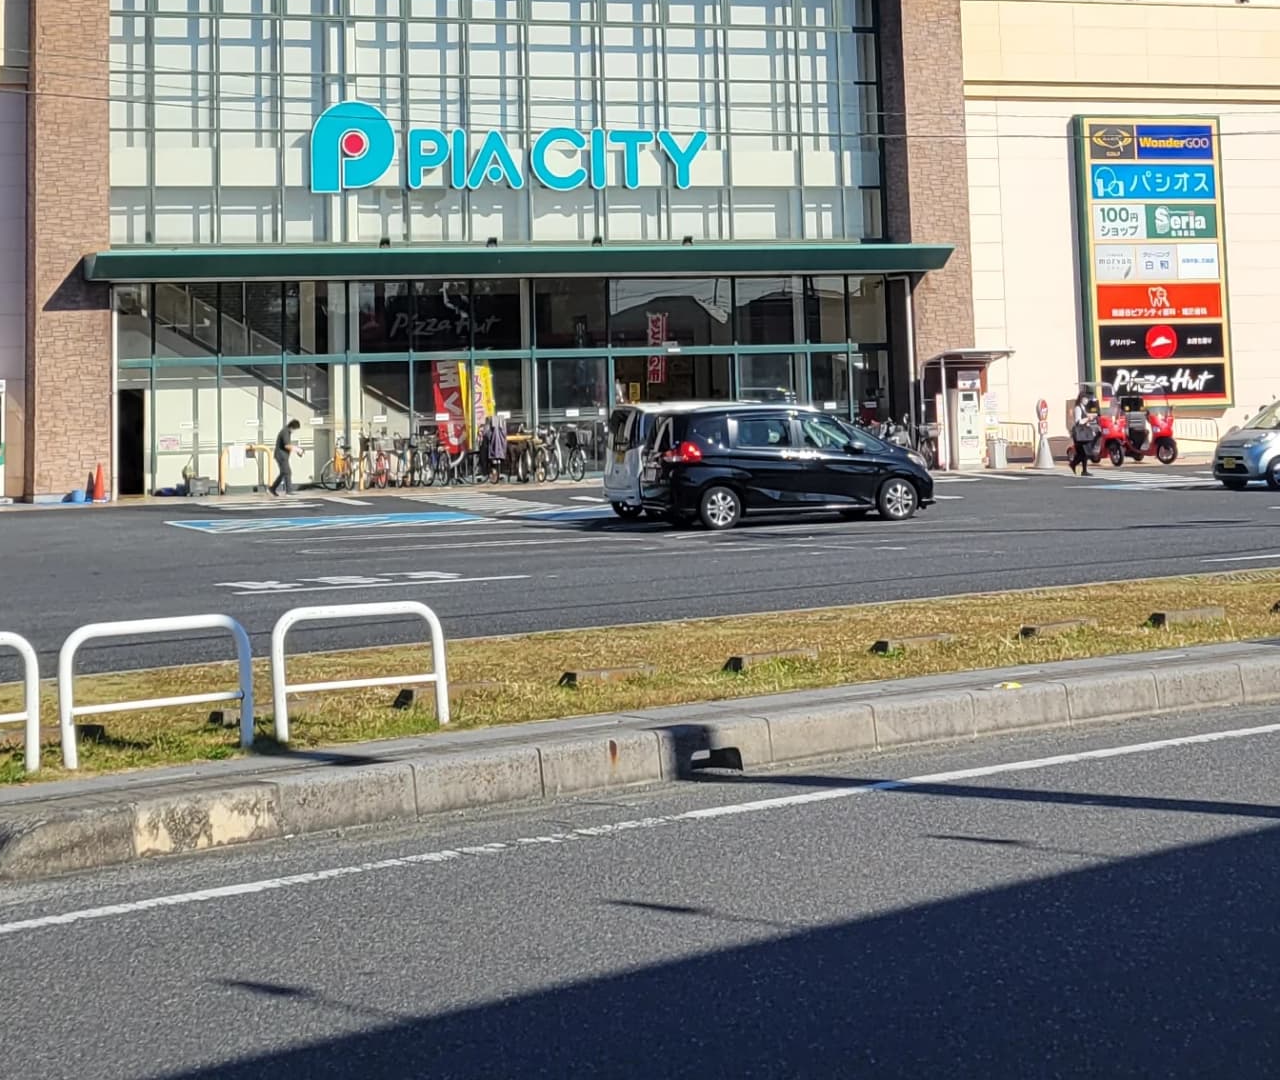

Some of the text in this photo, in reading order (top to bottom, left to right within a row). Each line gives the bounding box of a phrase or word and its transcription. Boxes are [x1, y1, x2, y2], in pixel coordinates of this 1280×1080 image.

[1139, 137, 1209, 148] WonderGOO
[1130, 171, 1209, 192] パシオス
[1100, 207, 1138, 223] 100円
[1155, 206, 1206, 234] Seria
[1101, 225, 1138, 237] ショップ
[1170, 368, 1215, 392] Hut
